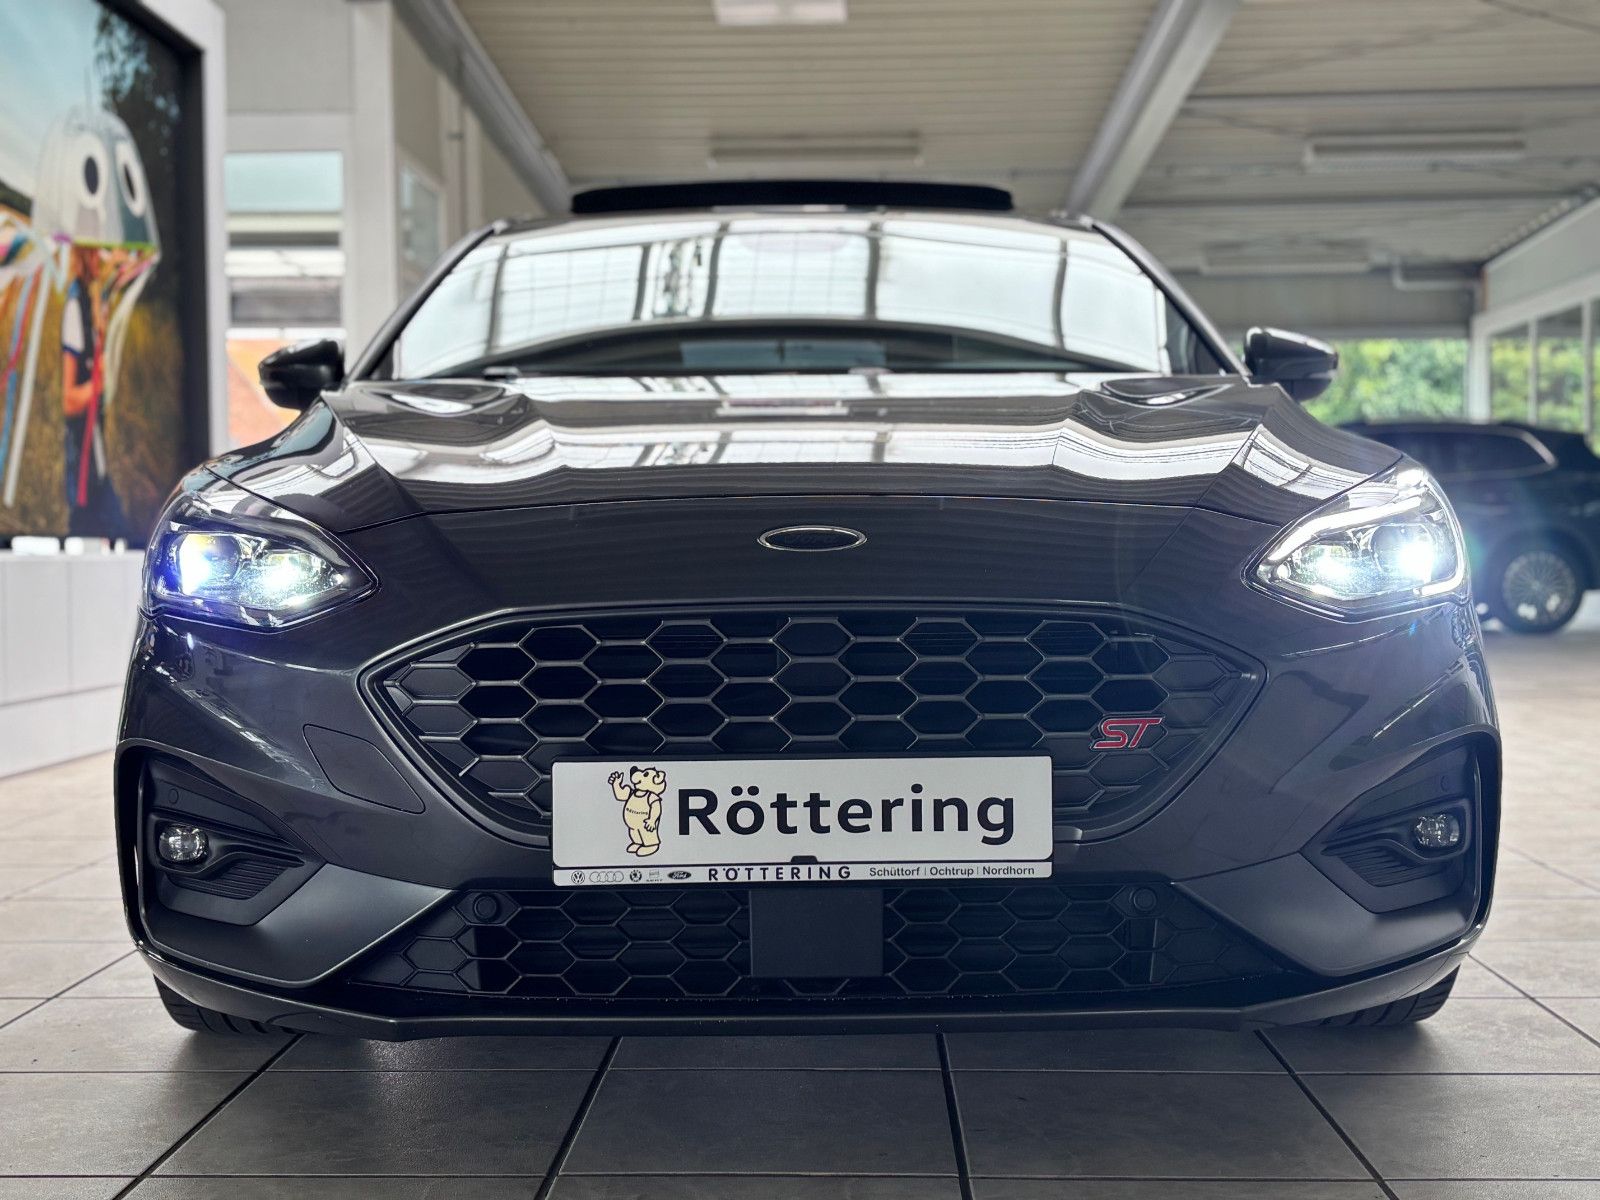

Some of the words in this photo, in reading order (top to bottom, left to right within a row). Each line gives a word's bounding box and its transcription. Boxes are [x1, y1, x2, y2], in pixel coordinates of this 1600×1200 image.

[1092, 717, 1163, 749] ST
[678, 783, 1014, 845] Röttering
[708, 866, 851, 881] RÖTTERING
[869, 866, 920, 877] Schüttorf
[929, 866, 974, 877] Ochtrup
[982, 865, 1035, 876] Nordhorn
